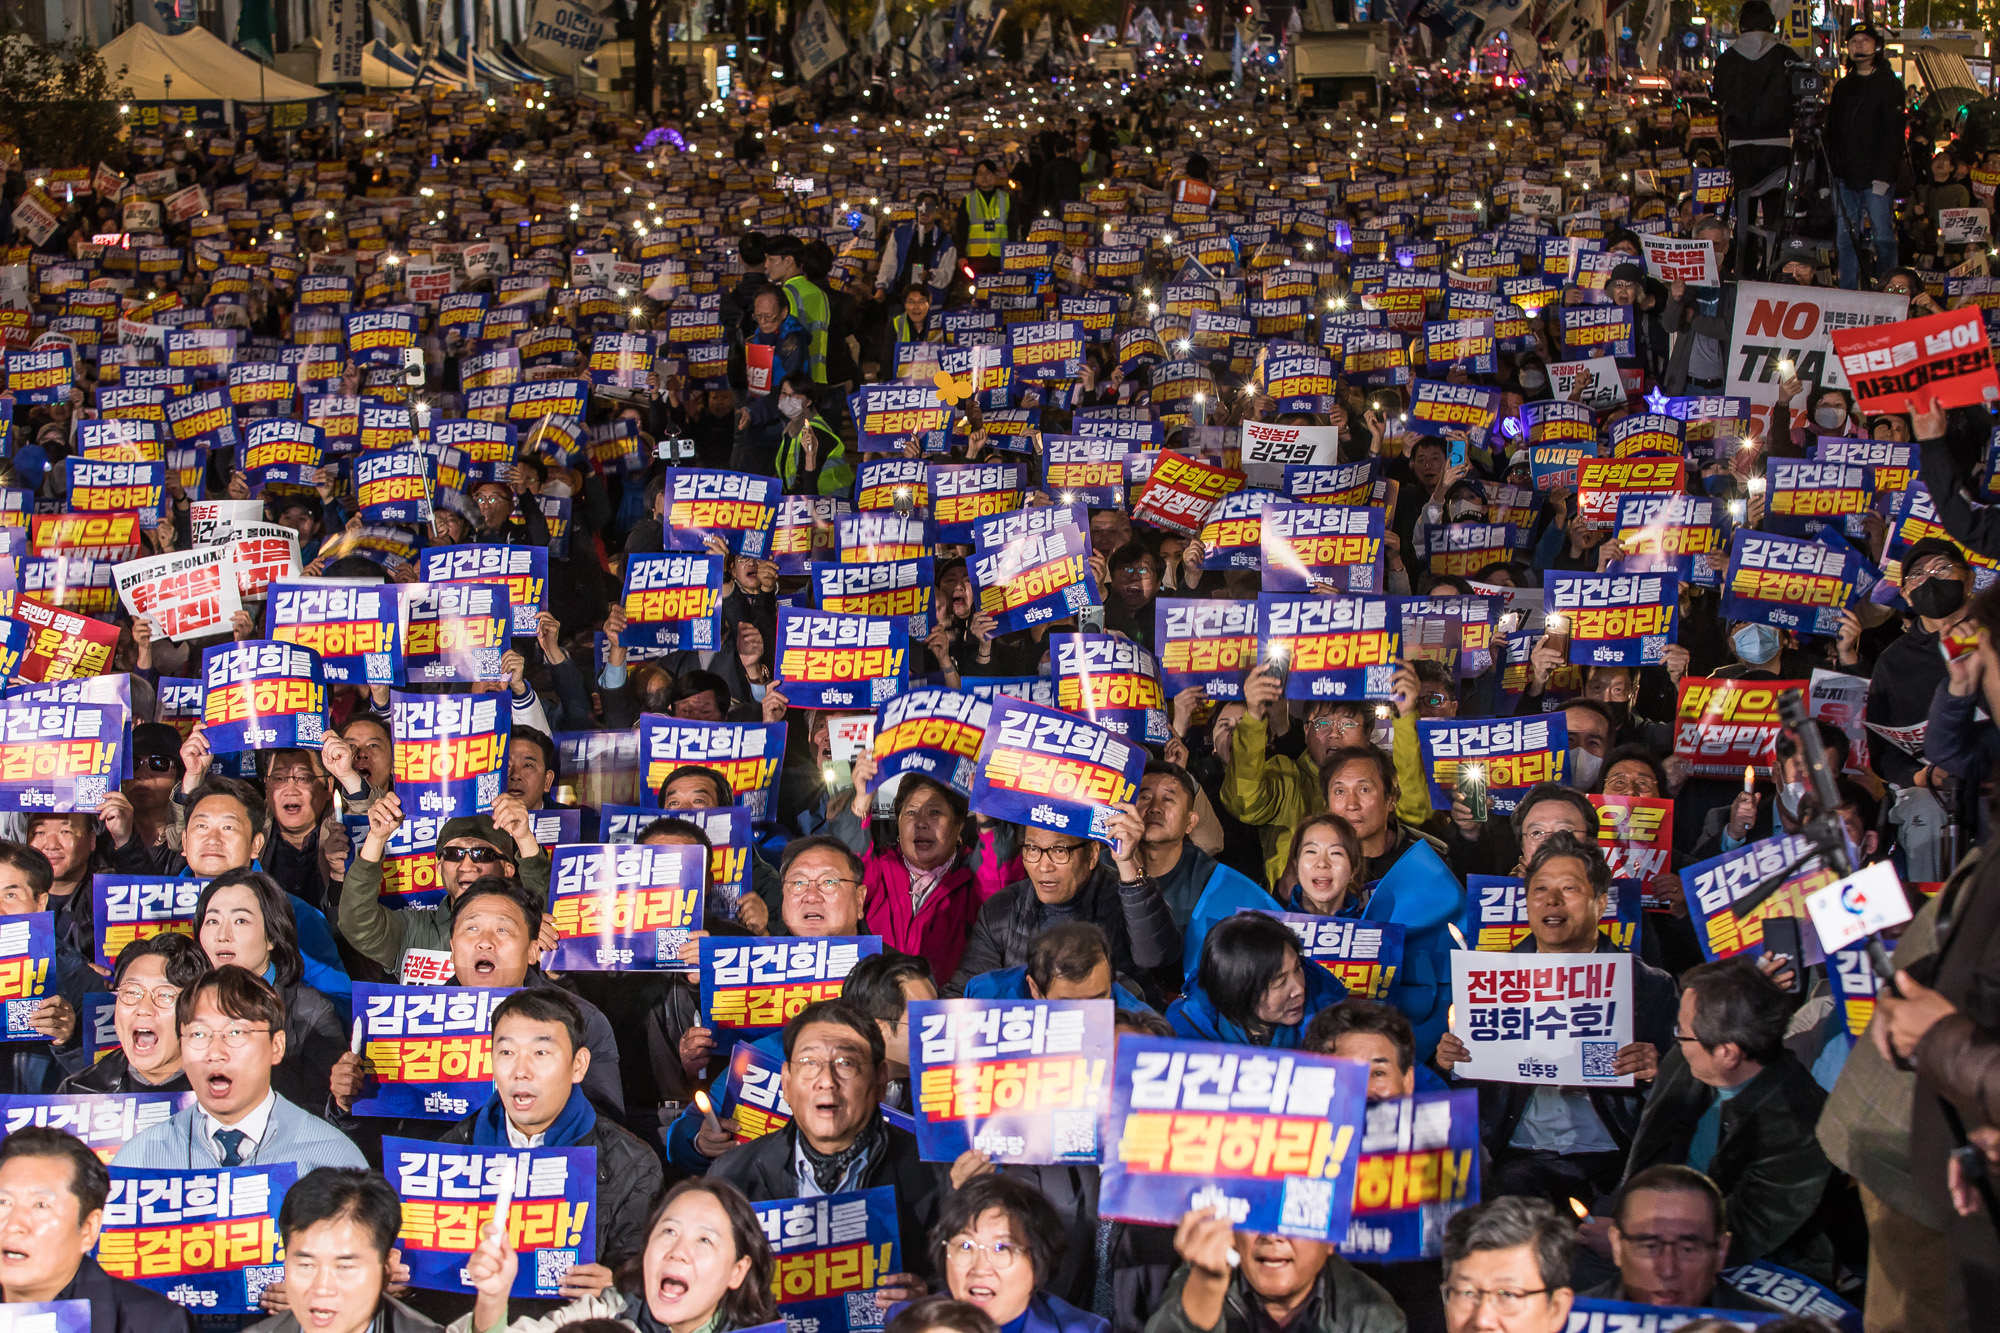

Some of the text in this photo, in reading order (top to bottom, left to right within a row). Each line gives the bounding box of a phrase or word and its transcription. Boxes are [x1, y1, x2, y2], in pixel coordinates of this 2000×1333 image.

[1651, 250, 1705, 265] 윤석열
[1674, 242, 1709, 250] 몰아내자!
[1467, 252, 1515, 267] 김건희를
[1268, 272, 1311, 289] 김건희를
[1661, 266, 1704, 282] 퇴진!
[440, 294, 482, 311] 김건희를
[1062, 299, 1110, 313] 김건희를
[349, 313, 411, 334] 김건희를
[439, 308, 486, 326] 특검하라!
[670, 311, 718, 325] 김건희를
[1197, 314, 1252, 332] 김건희를
[1565, 308, 1624, 327] 김건희를
[1746, 299, 1820, 340] NO
[1824, 311, 1870, 325] 불법공사
[168, 332, 228, 349] 김건희를
[351, 330, 416, 352] 특검하라!
[594, 335, 647, 352] 김건희를
[669, 325, 723, 342] 특검하라!
[1012, 322, 1075, 345] 김건희를
[1427, 322, 1484, 340] 김건희를
[1565, 326, 1630, 346] 특검하라!
[1012, 341, 1082, 365] 특검하라!
[1428, 338, 1492, 361] 특검하라!
[1842, 341, 1918, 375] 퇴진을
[1925, 320, 1980, 356] 넘어
[8, 352, 65, 372] 김건희를
[229, 363, 289, 385] 김건희를
[461, 352, 510, 374] 김건희를
[589, 352, 652, 371] 특검하라!
[1269, 358, 1332, 378] 김건희를
[1856, 347, 1992, 400] 사회대전환!
[8, 368, 72, 390] 특검하라!
[513, 383, 578, 400] 김건희를
[1267, 376, 1337, 398] 특검하라!
[229, 381, 295, 404] 특검하라!
[867, 389, 941, 412] 김건희를
[1418, 383, 1489, 408] 김건희를
[166, 391, 222, 421] 김건희를
[509, 398, 584, 419] 특검하라!
[1292, 401, 1312, 411] 민주당
[1413, 401, 1493, 428] 특검하라!
[1527, 402, 1590, 423] 김건희를
[83, 422, 155, 447] 김건희를
[172, 407, 232, 441] 특검하라!
[249, 422, 316, 447] 김건희를
[436, 423, 507, 443] 김건희를
[864, 411, 950, 433] 특검하라!
[1248, 425, 1300, 443] 국정농단
[1613, 414, 1679, 437] 김건희를
[245, 441, 320, 470] 특검하라!
[1049, 440, 1129, 463] 김건희를
[1249, 440, 1317, 465] 김건희
[1614, 434, 1683, 459] 특검하라!
[1825, 444, 1910, 466] 김건희를
[73, 462, 152, 486] 김건희를
[265, 469, 289, 480] 민주당
[357, 454, 429, 483] 김건희를
[1153, 458, 1242, 499] 탄핵으로
[1292, 459, 1371, 495] 김건희를
[1580, 462, 1679, 487] 탄핵으로
[1775, 464, 1863, 489] 김건희를
[358, 477, 436, 509] 특검하라!
[673, 473, 767, 503] 김건희를
[935, 467, 1018, 496] 김건희를
[71, 485, 162, 511] 특검하라!
[934, 491, 1022, 523] 특검하라!
[1770, 490, 1872, 516] 특검하라!
[382, 509, 406, 519] 민주당
[669, 501, 775, 531] 특검하라!
[1270, 508, 1369, 536] 김건희를
[1622, 500, 1712, 526] 김건희를
[35, 515, 134, 547] 탄핵으로
[840, 516, 924, 548] 김건희를
[982, 507, 1073, 548] 김건희를
[121, 548, 226, 590] 참지말고 몰아내자!
[427, 548, 533, 582] 김건희를
[975, 531, 1067, 587] 김건희를
[1741, 538, 1846, 577] 김건희를
[629, 558, 709, 590] 김건희를
[820, 562, 919, 595] 김건희를
[980, 555, 1085, 615] 특검하라!
[132, 565, 220, 613] 윤석열
[1553, 576, 1662, 606] 김건희를
[1732, 569, 1853, 608] 특검하라!
[275, 591, 381, 624] 김건희를
[625, 588, 720, 622] 특검하라!
[1024, 608, 1053, 624] 민주당
[1268, 600, 1387, 632] 김건희를
[18, 601, 86, 636] 국민의 명령
[785, 615, 892, 647] 김건희를
[1769, 611, 1799, 627] 민주당
[34, 629, 112, 670] 윤석열
[656, 631, 680, 645] 민주당
[208, 647, 313, 688] 김건희를
[780, 647, 905, 681] 특검하라!
[1058, 640, 1155, 677] 김건희를
[1593, 648, 1625, 662] 민주당
[424, 664, 456, 678] 민주당
[821, 691, 854, 705] 민주당
[1206, 682, 1239, 697] 민주당
[1312, 682, 1347, 696] 민주당
[205, 685, 323, 723] 특검하라!
[393, 699, 498, 738] 김건희를
[243, 729, 278, 744] 민주당
[649, 726, 767, 760] 김건희를
[1000, 709, 1130, 772] 김건희를
[1429, 721, 1550, 756] 김건희를
[393, 734, 506, 782] 특검하라!
[985, 748, 1136, 806] 특검하라!
[19, 791, 56, 808] 민주당
[420, 795, 456, 811] 민주당
[1030, 808, 1070, 828] 민주당
[557, 848, 682, 894] 김건희를
[552, 889, 698, 936] 특검하라!
[596, 948, 634, 964] 민주당
[713, 946, 859, 985] 김건희를
[1467, 962, 1615, 1005] 전쟁반대!
[921, 1005, 1085, 1062] 김건희를
[1469, 1001, 1615, 1042] 평화수호!
[1517, 1062, 1558, 1079] 민주당
[920, 1059, 1106, 1118] 특검하라!
[1131, 1052, 1336, 1115] 김건희를
[424, 1095, 469, 1114] 민주당
[974, 1136, 1025, 1156] 민주당
[1119, 1113, 1354, 1179] 특검하라!
[398, 1152, 568, 1198] 김건희를
[104, 1172, 270, 1224] 김건희를
[400, 1201, 588, 1250] 특검하라!
[97, 1218, 286, 1278] 특검하라!
[167, 1290, 218, 1307] 민주당
